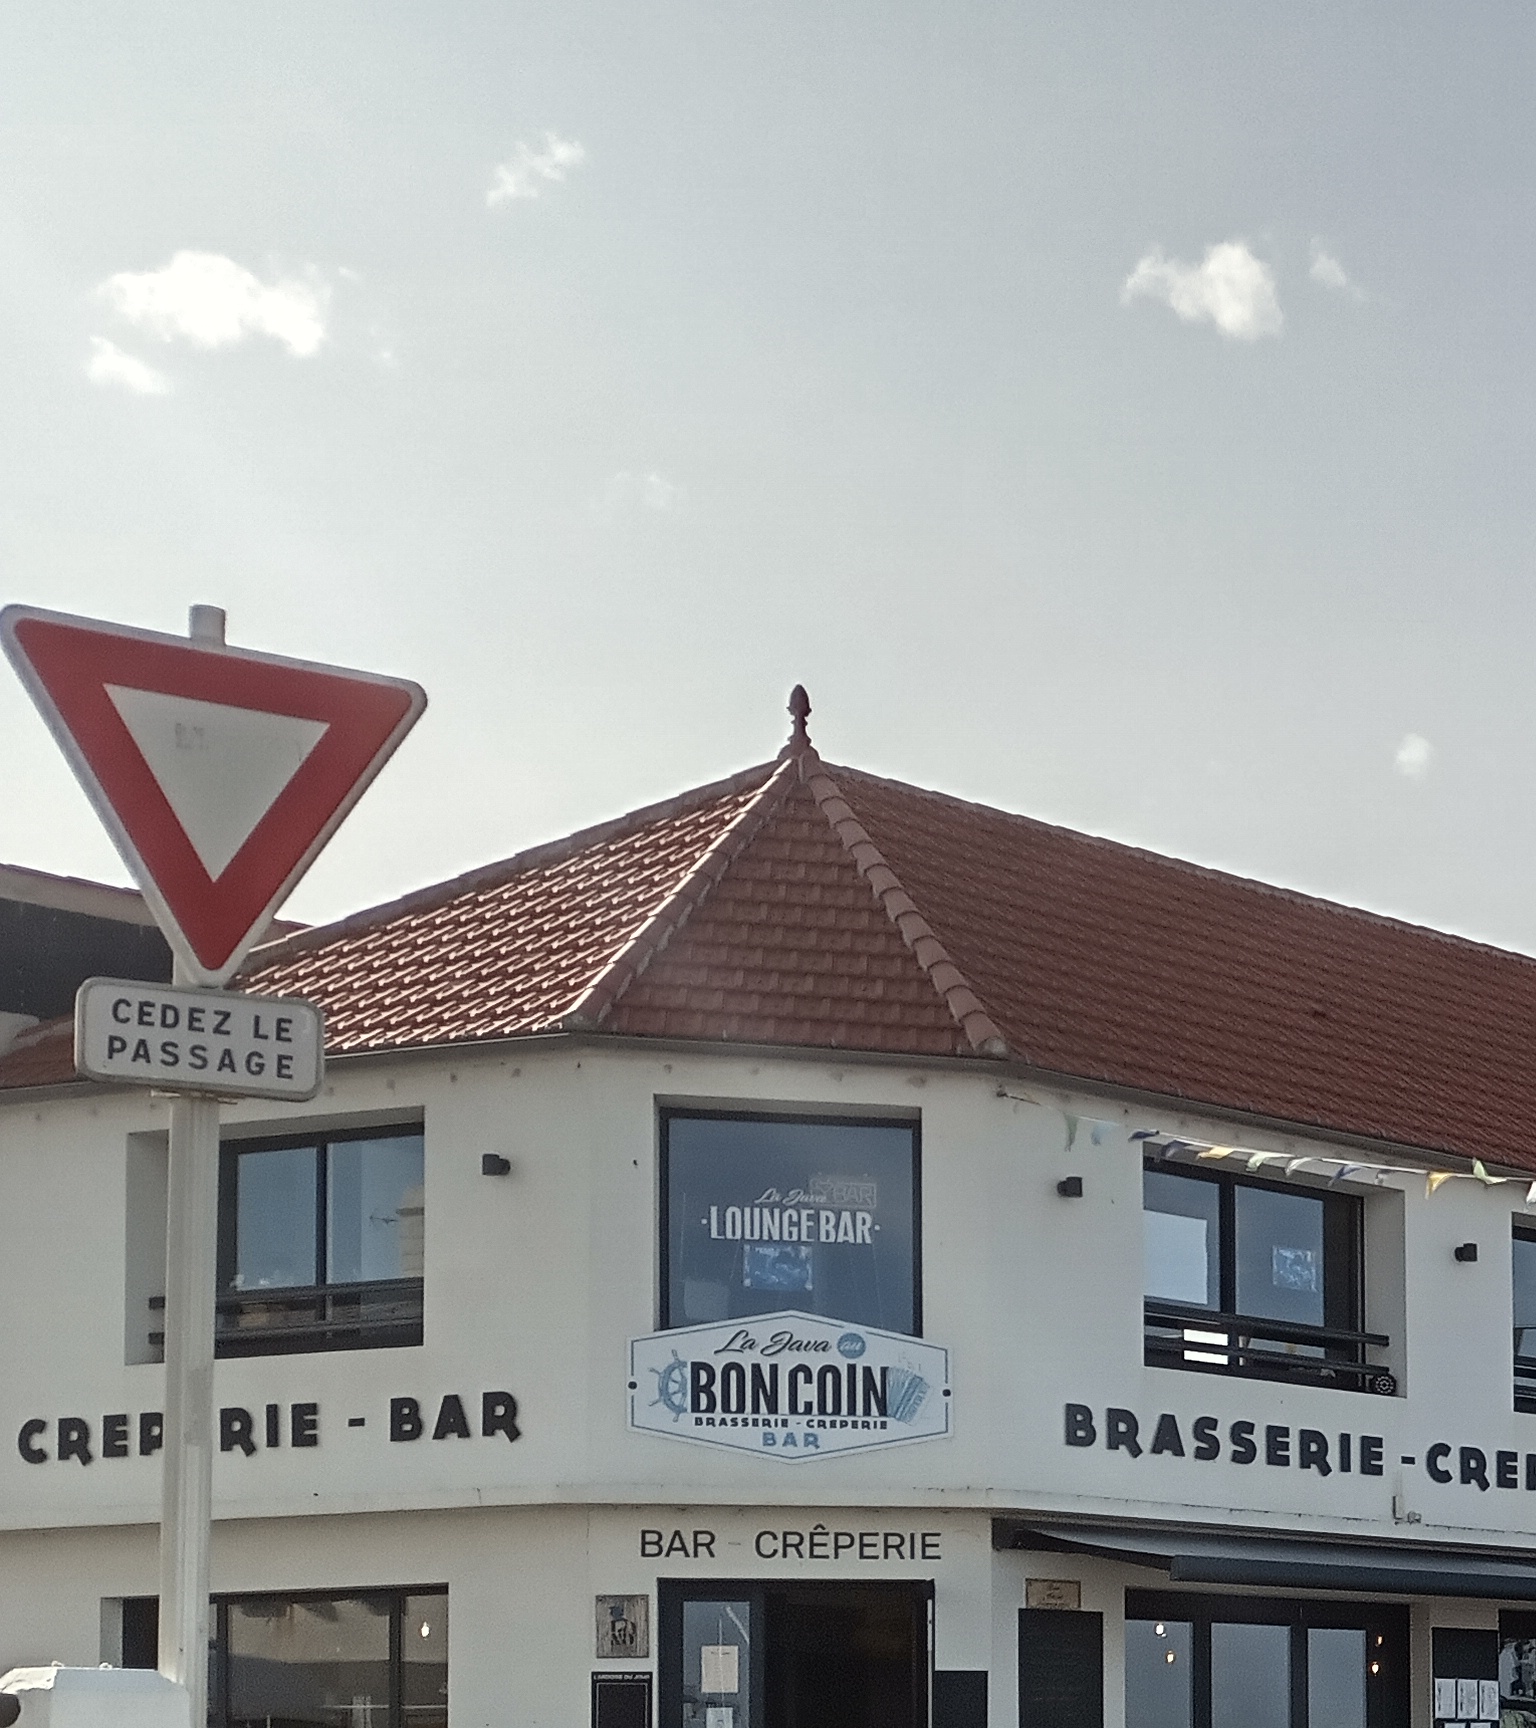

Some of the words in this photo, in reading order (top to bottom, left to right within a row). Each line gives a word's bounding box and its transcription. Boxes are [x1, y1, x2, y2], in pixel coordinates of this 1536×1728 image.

[110, 998, 232, 1036] CEDEZ
[252, 1013, 295, 1043] LE
[106, 1035, 295, 1080] PASSAGE
[710, 1205, 815, 1242] LOUNGE
[818, 1209, 873, 1244] BAR
[713, 1329, 759, 1355] La
[760, 1331, 832, 1356] Java
[689, 1360, 779, 1417] BON
[787, 1362, 890, 1418] COIN
[18, 1402, 319, 1467] CREPRIE
[389, 1391, 522, 1444] BAR
[694, 1416, 790, 1429] BRASSERIE
[805, 1419, 889, 1430] CREPERIE
[762, 1431, 820, 1449] BAR
[1064, 1402, 1385, 1478] BRASSERIE
[640, 1528, 716, 1559] BAR
[754, 1523, 943, 1561] CRÊPERIE
